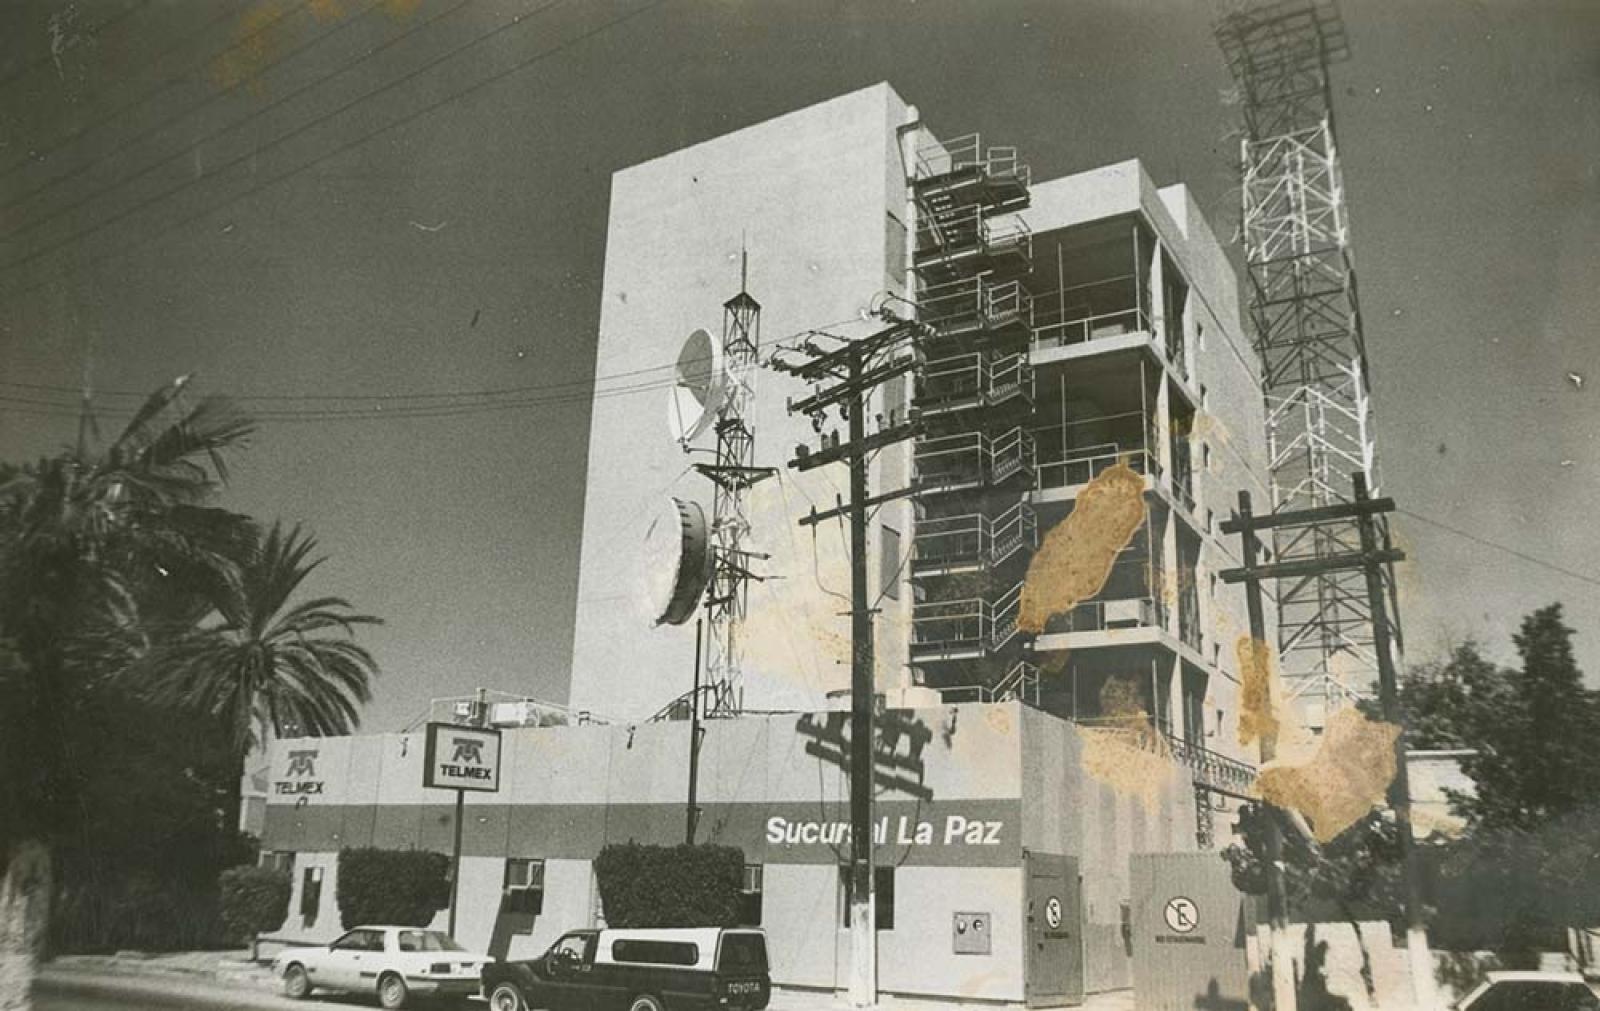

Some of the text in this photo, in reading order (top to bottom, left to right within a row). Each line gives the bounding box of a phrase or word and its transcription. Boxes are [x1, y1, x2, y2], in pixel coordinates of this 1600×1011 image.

[440, 764, 491, 780] TELMEX
[275, 781, 324, 794] TELMEX
[897, 816, 934, 845] La
[943, 815, 1003, 845] Paz
[728, 982, 761, 994] TOYOTA
